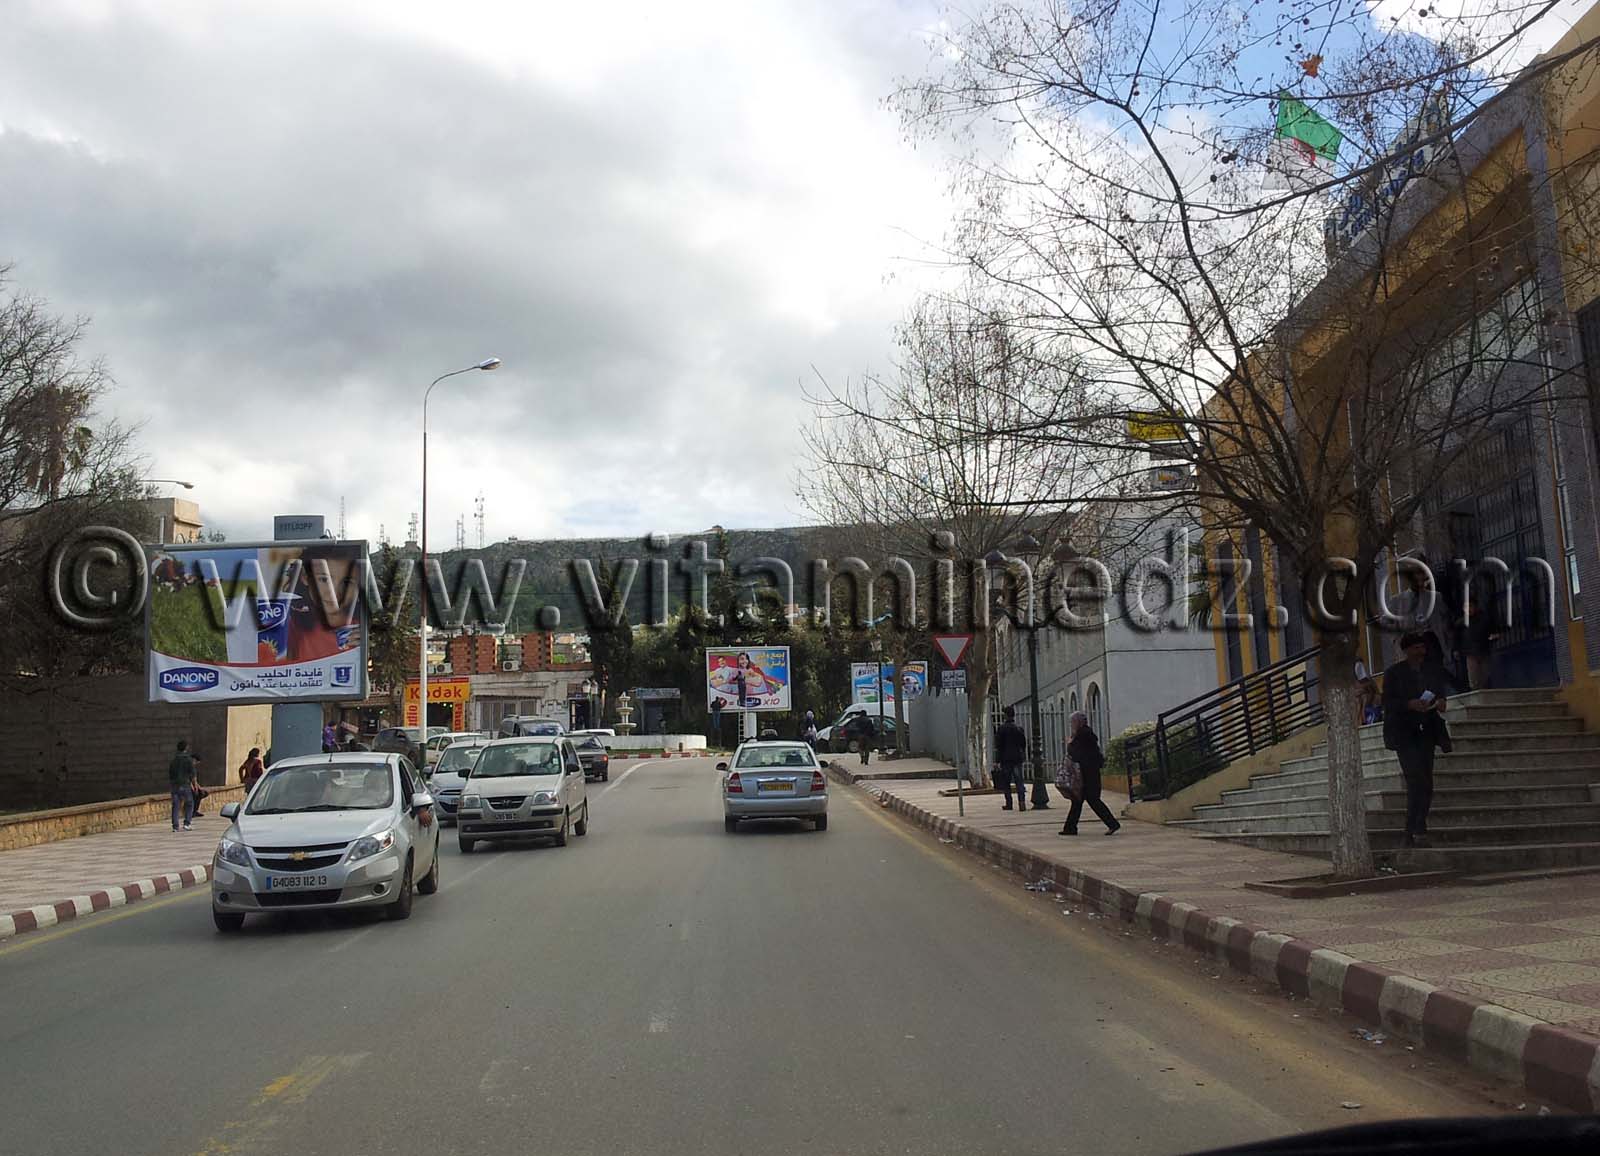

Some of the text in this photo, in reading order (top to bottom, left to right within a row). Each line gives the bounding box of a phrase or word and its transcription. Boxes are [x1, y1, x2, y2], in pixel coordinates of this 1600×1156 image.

[257, 668, 323, 681] فايدة الحليب
[230, 680, 261, 691] دانون
[410, 686, 462, 699] Kdak
[303, 875, 316, 887] 112
[318, 875, 328, 886] 13
